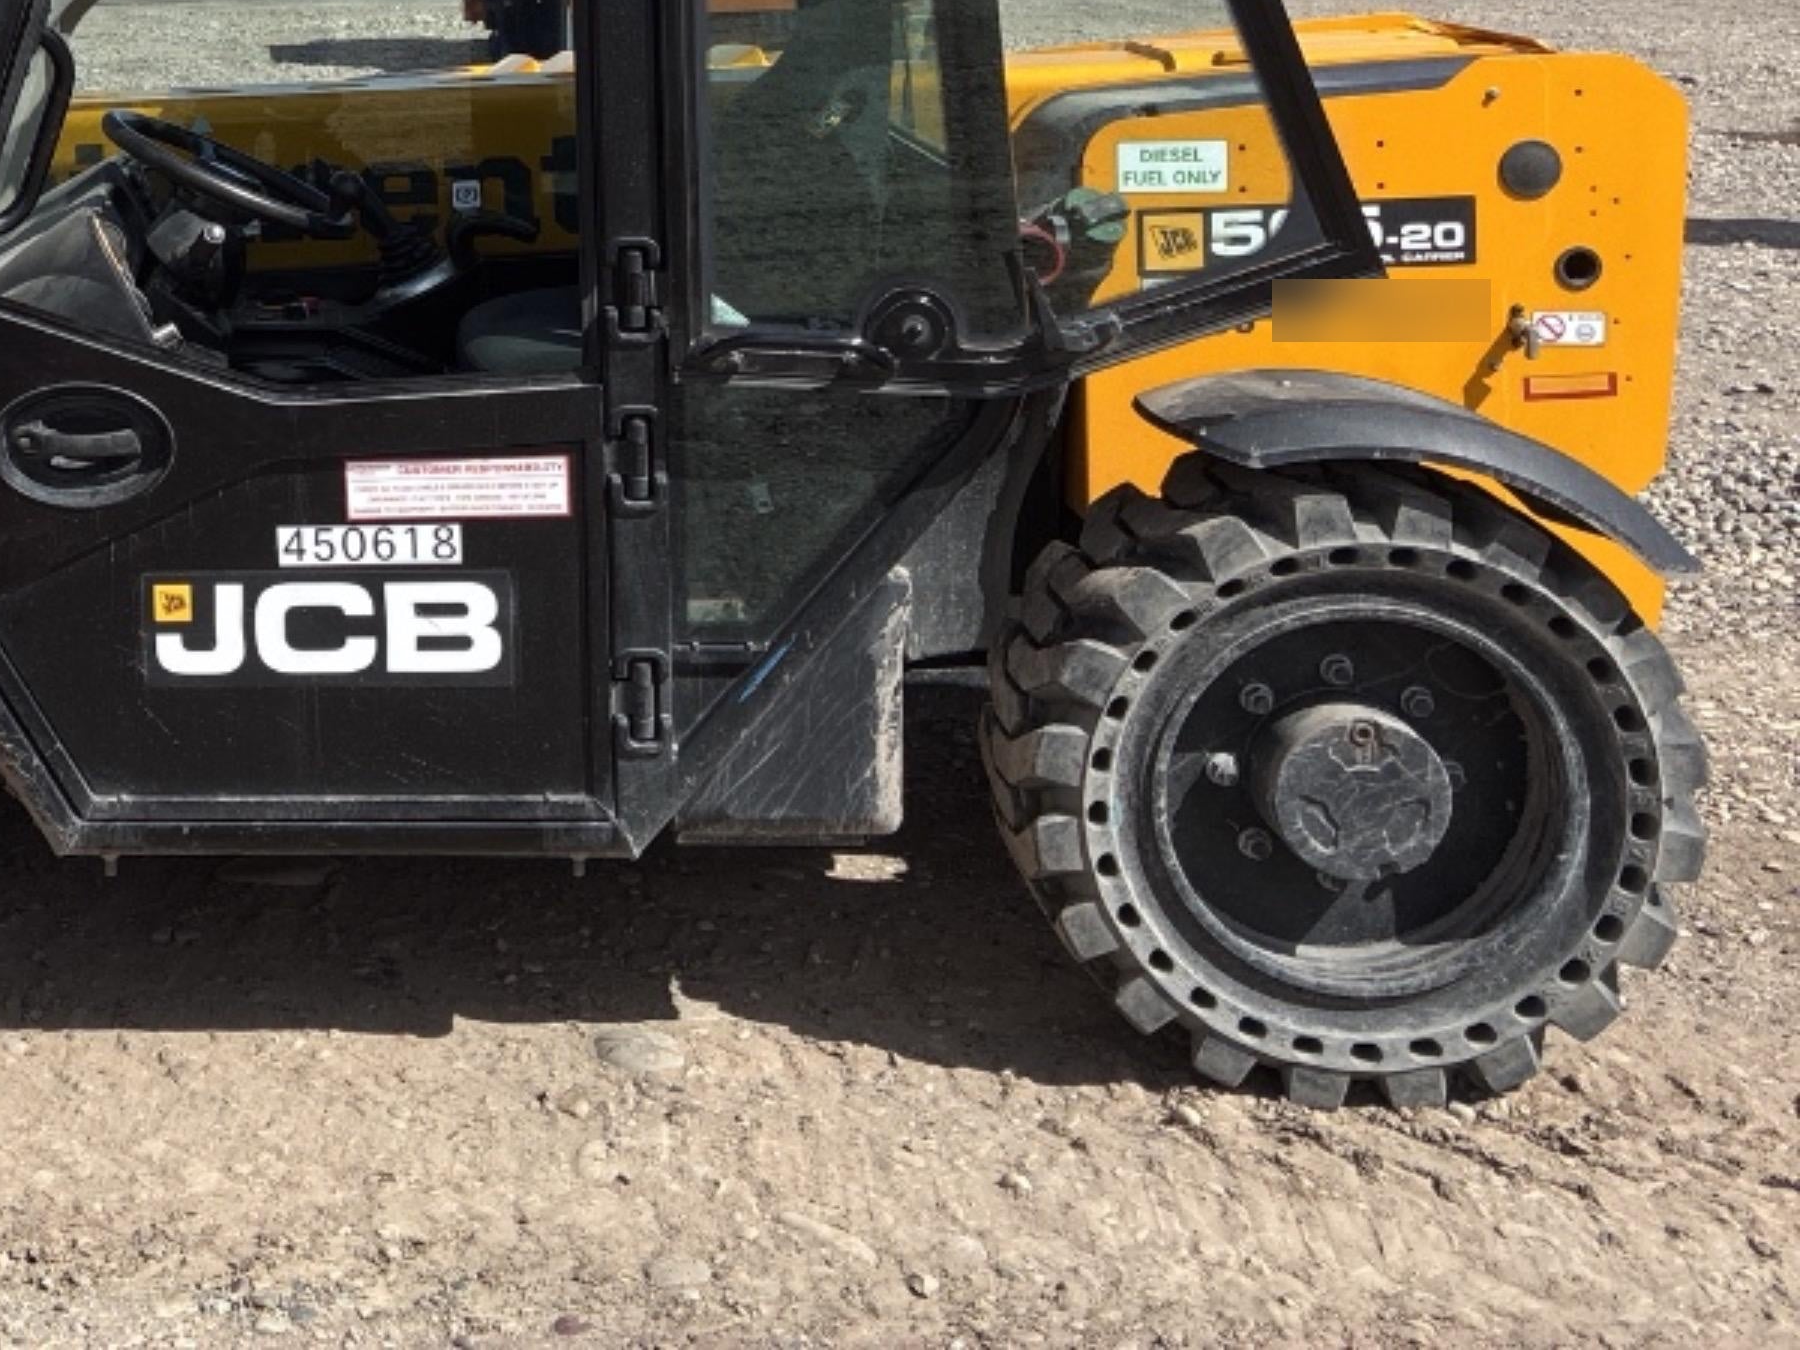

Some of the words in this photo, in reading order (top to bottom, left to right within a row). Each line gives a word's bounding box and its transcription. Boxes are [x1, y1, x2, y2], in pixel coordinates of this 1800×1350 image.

[1139, 146, 1204, 164] DIESEL
[1122, 170, 1166, 188] FUEL
[1172, 168, 1222, 187] ONLY
[1210, 203, 1466, 258] 5-20
[283, 526, 457, 563] 450618
[154, 581, 502, 676] JCB
